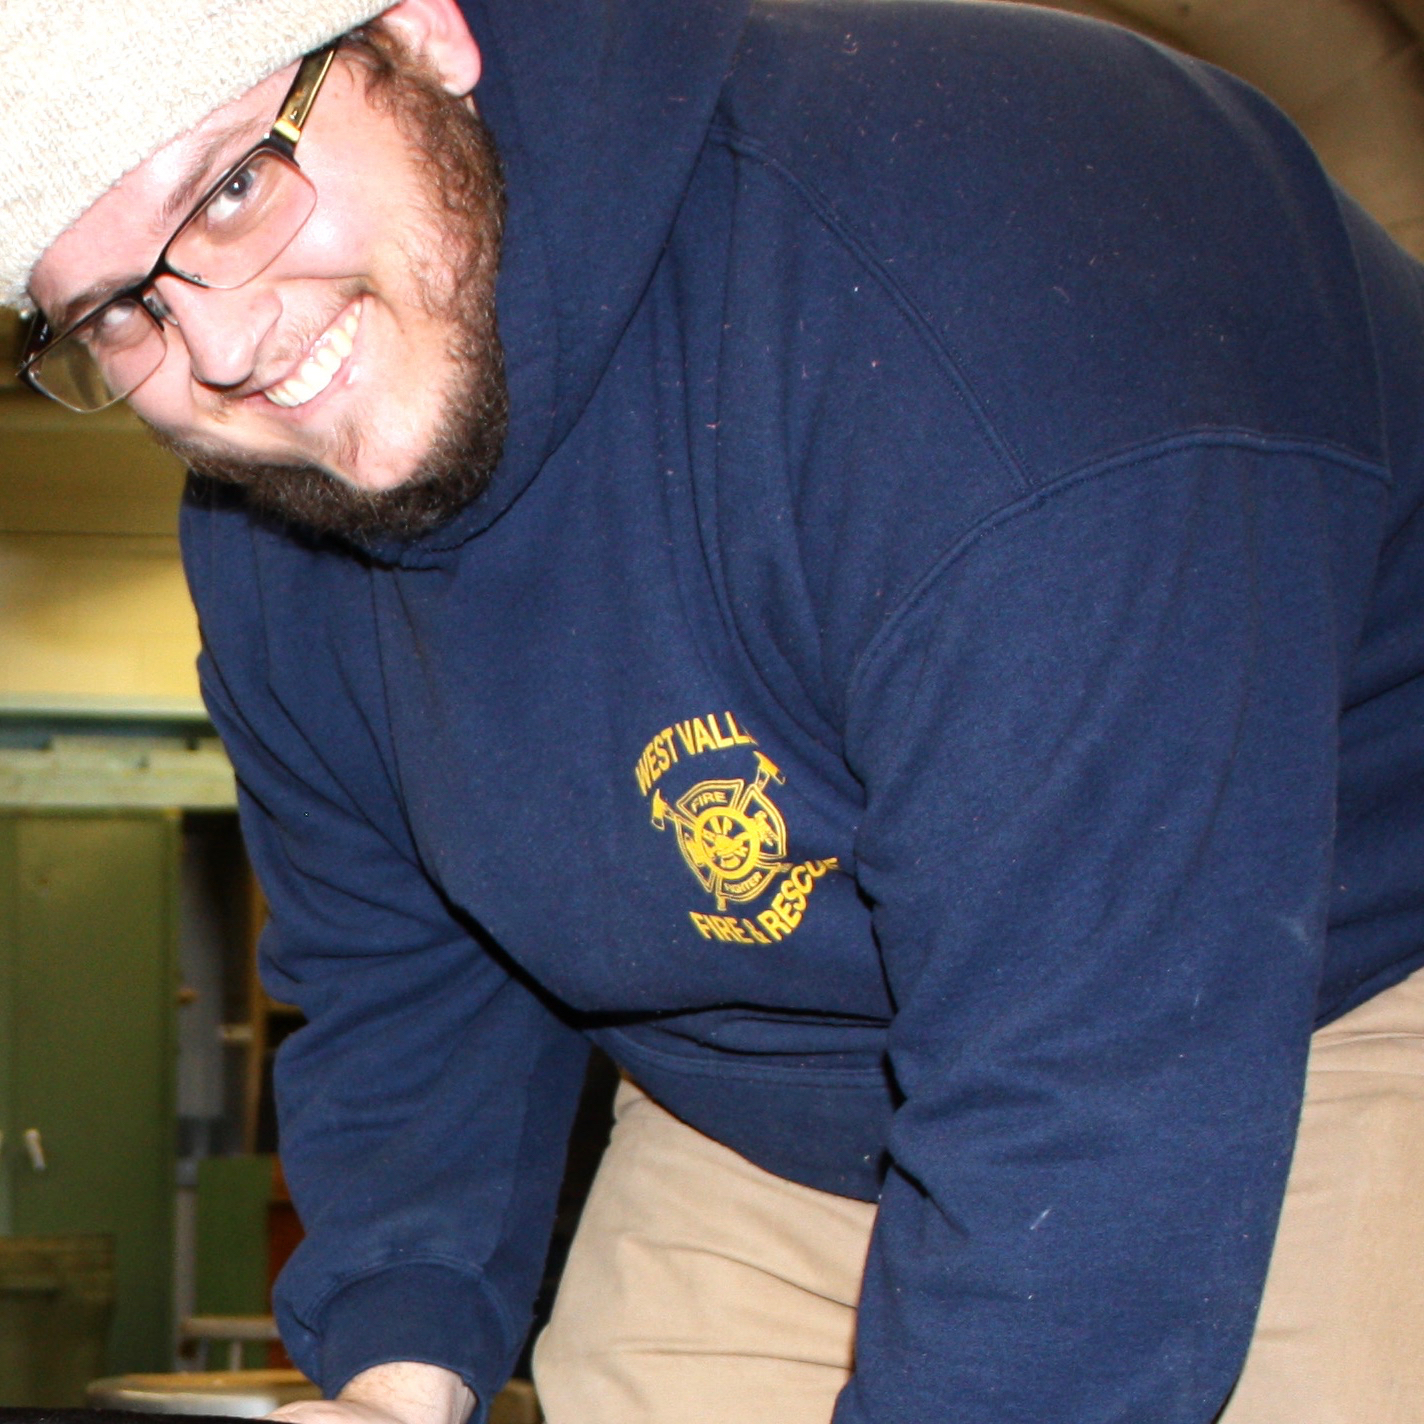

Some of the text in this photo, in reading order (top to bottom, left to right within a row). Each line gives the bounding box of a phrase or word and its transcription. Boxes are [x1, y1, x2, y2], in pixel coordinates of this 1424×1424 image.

[634, 711, 758, 796] WEST VALL
[690, 791, 728, 813] FIRE
[689, 911, 755, 943] FIRE
[742, 918, 773, 943] &
